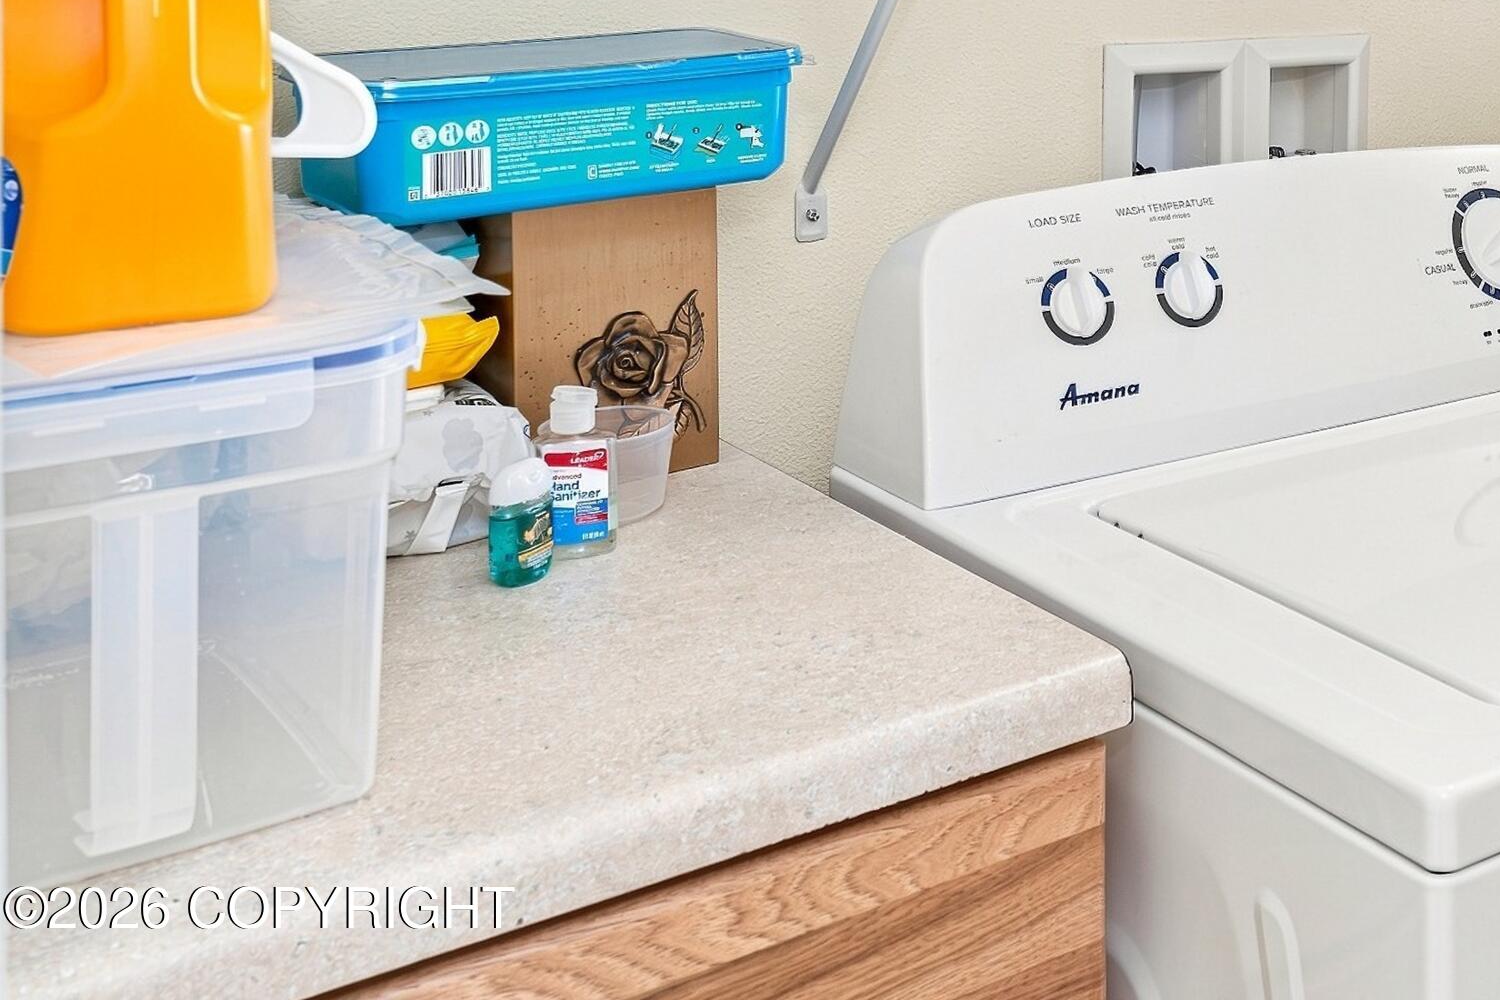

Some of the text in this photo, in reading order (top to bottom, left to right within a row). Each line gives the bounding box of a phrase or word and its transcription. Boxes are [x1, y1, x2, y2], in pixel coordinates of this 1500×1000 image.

[1457, 164, 1490, 176] NORMAL
[1114, 196, 1216, 218] WASH TEMPERATURE
[1027, 212, 1082, 229] LOAD SIZE
[1156, 214, 1172, 222] cold
[1052, 257, 1082, 267] medium
[1424, 263, 1457, 276] CASUAL
[1059, 382, 1141, 411] Amana
[552, 473, 582, 481] dvanced
